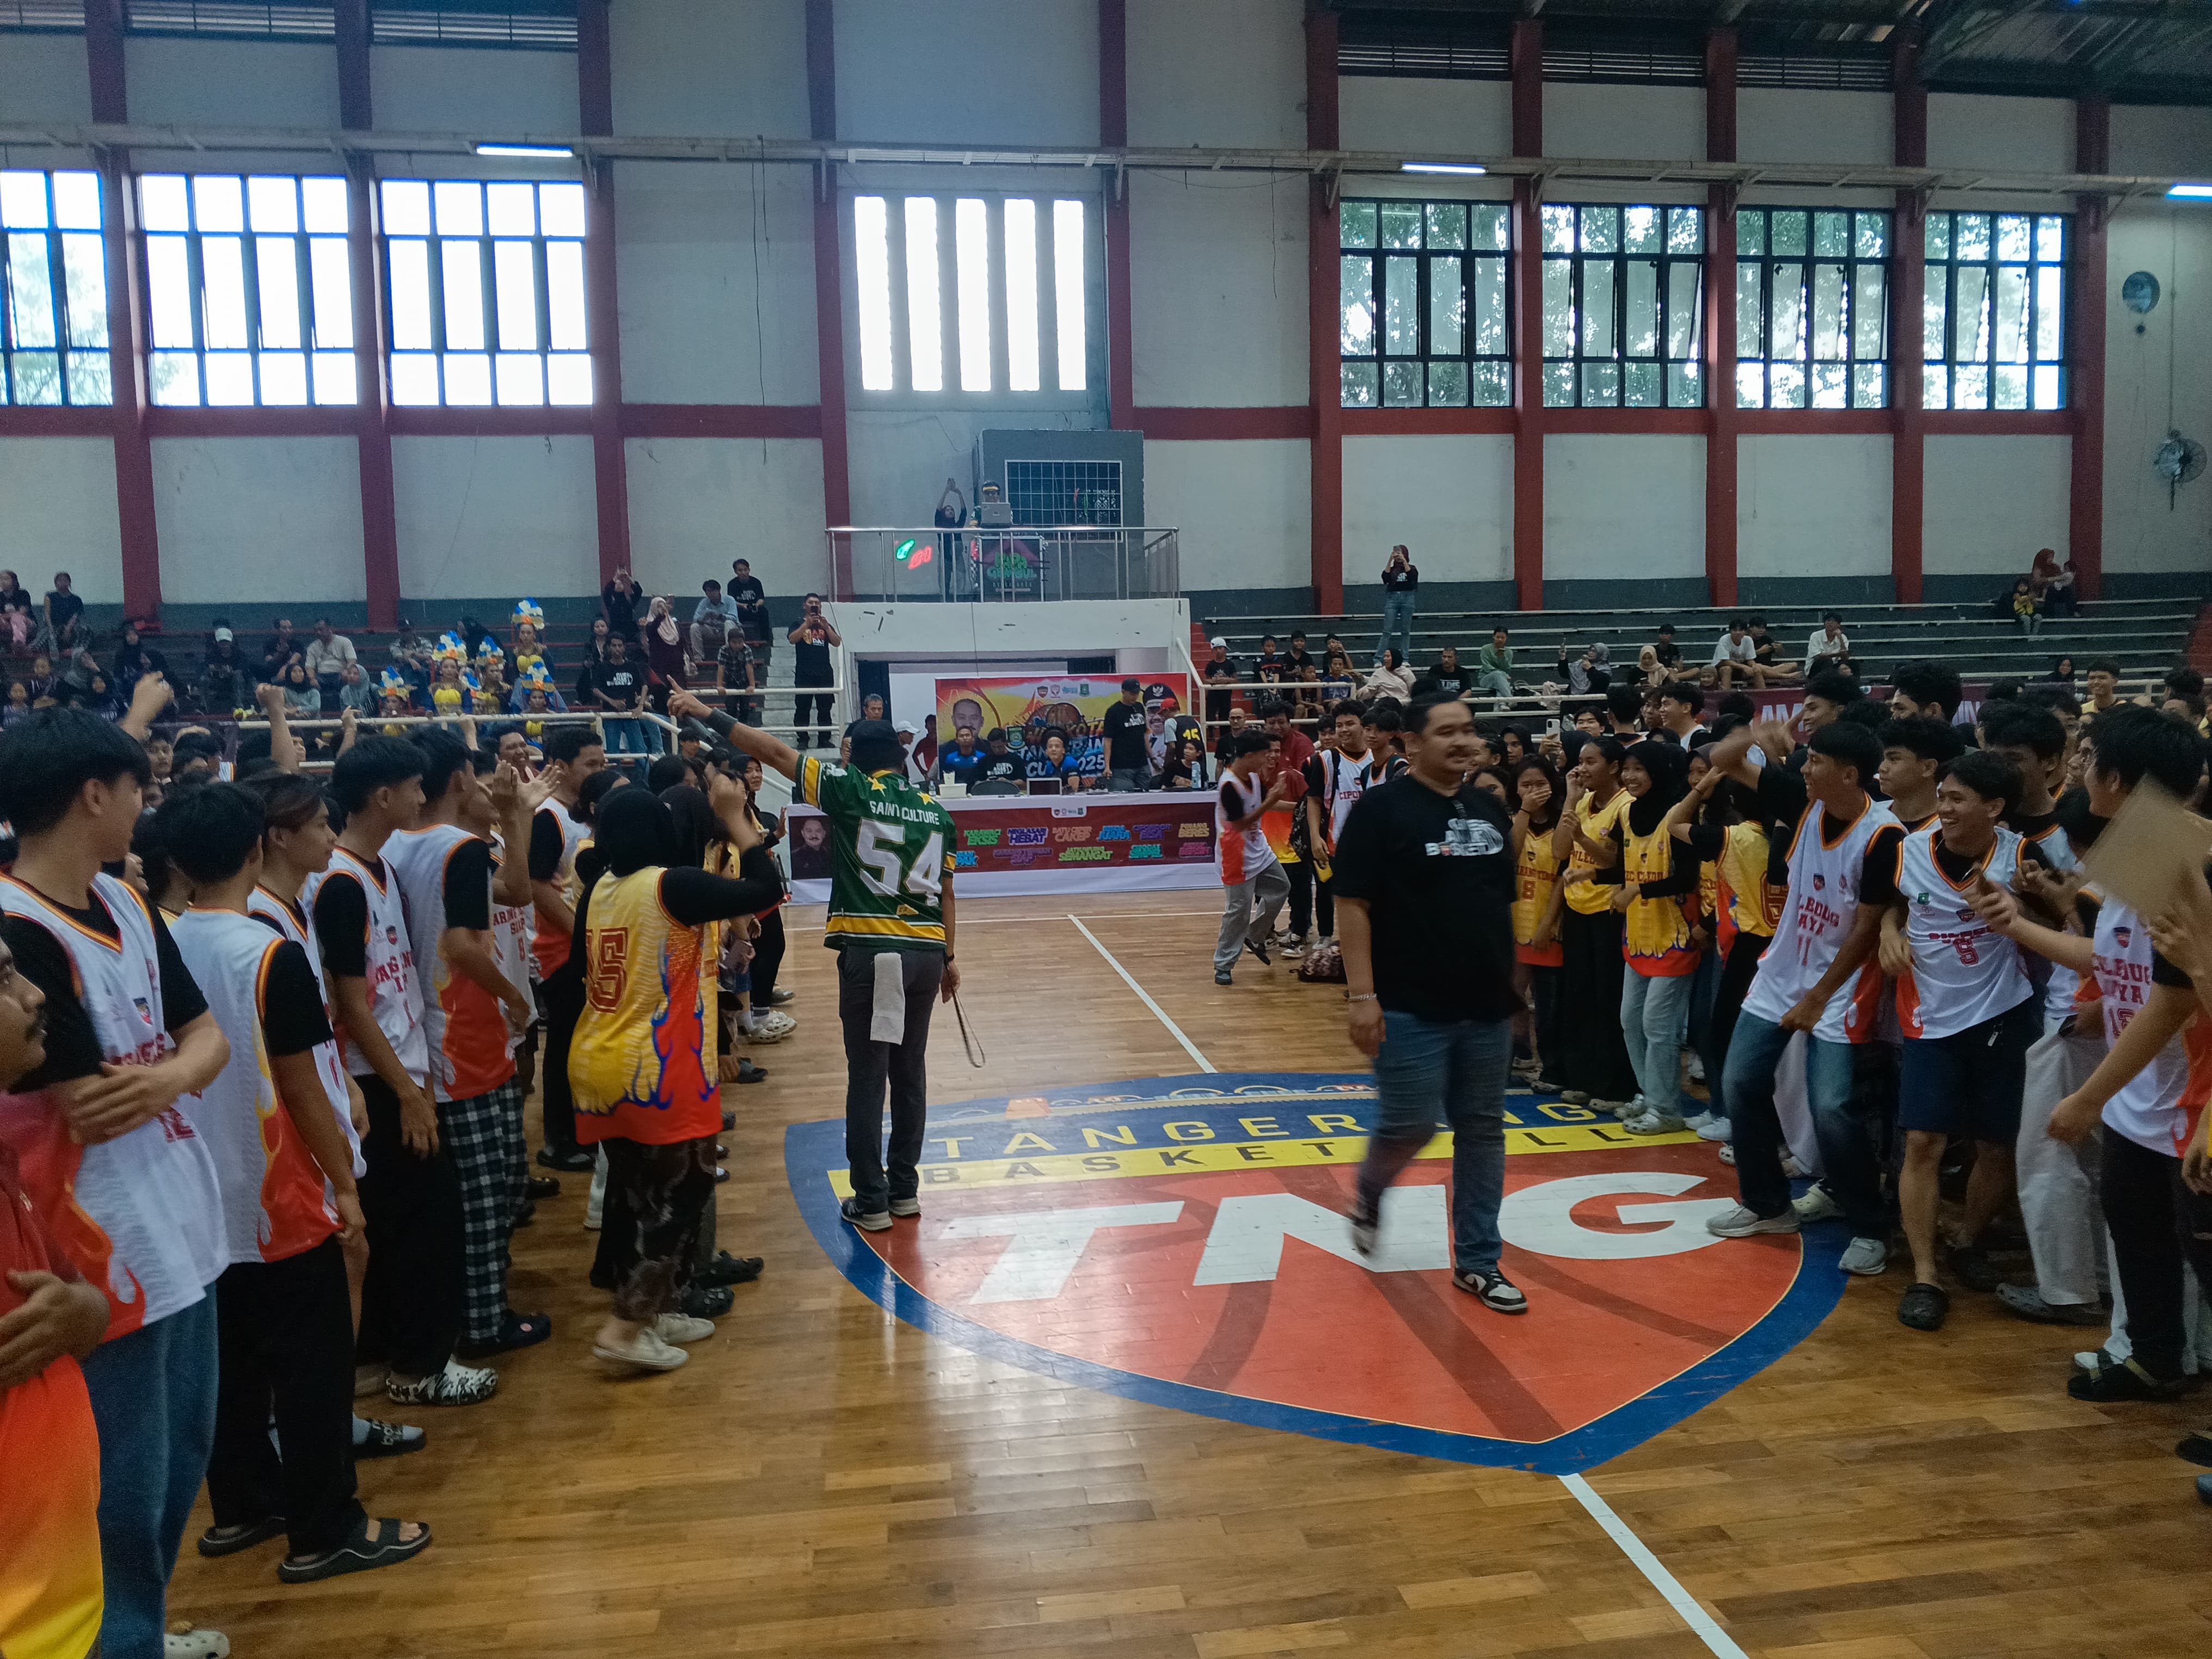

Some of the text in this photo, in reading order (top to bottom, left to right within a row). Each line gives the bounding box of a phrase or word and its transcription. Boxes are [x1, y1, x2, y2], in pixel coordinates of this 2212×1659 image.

[901, 807, 941, 826] CULTURE
[1009, 833, 1046, 845] HEBAT
[855, 817, 944, 908] 54
[1059, 851, 1114, 862] SEMANGAT
[923, 1127, 1635, 1185] BASKETLL
[928, 1103, 1597, 1158] TANGERG
[937, 1171, 1742, 1305] TNG
